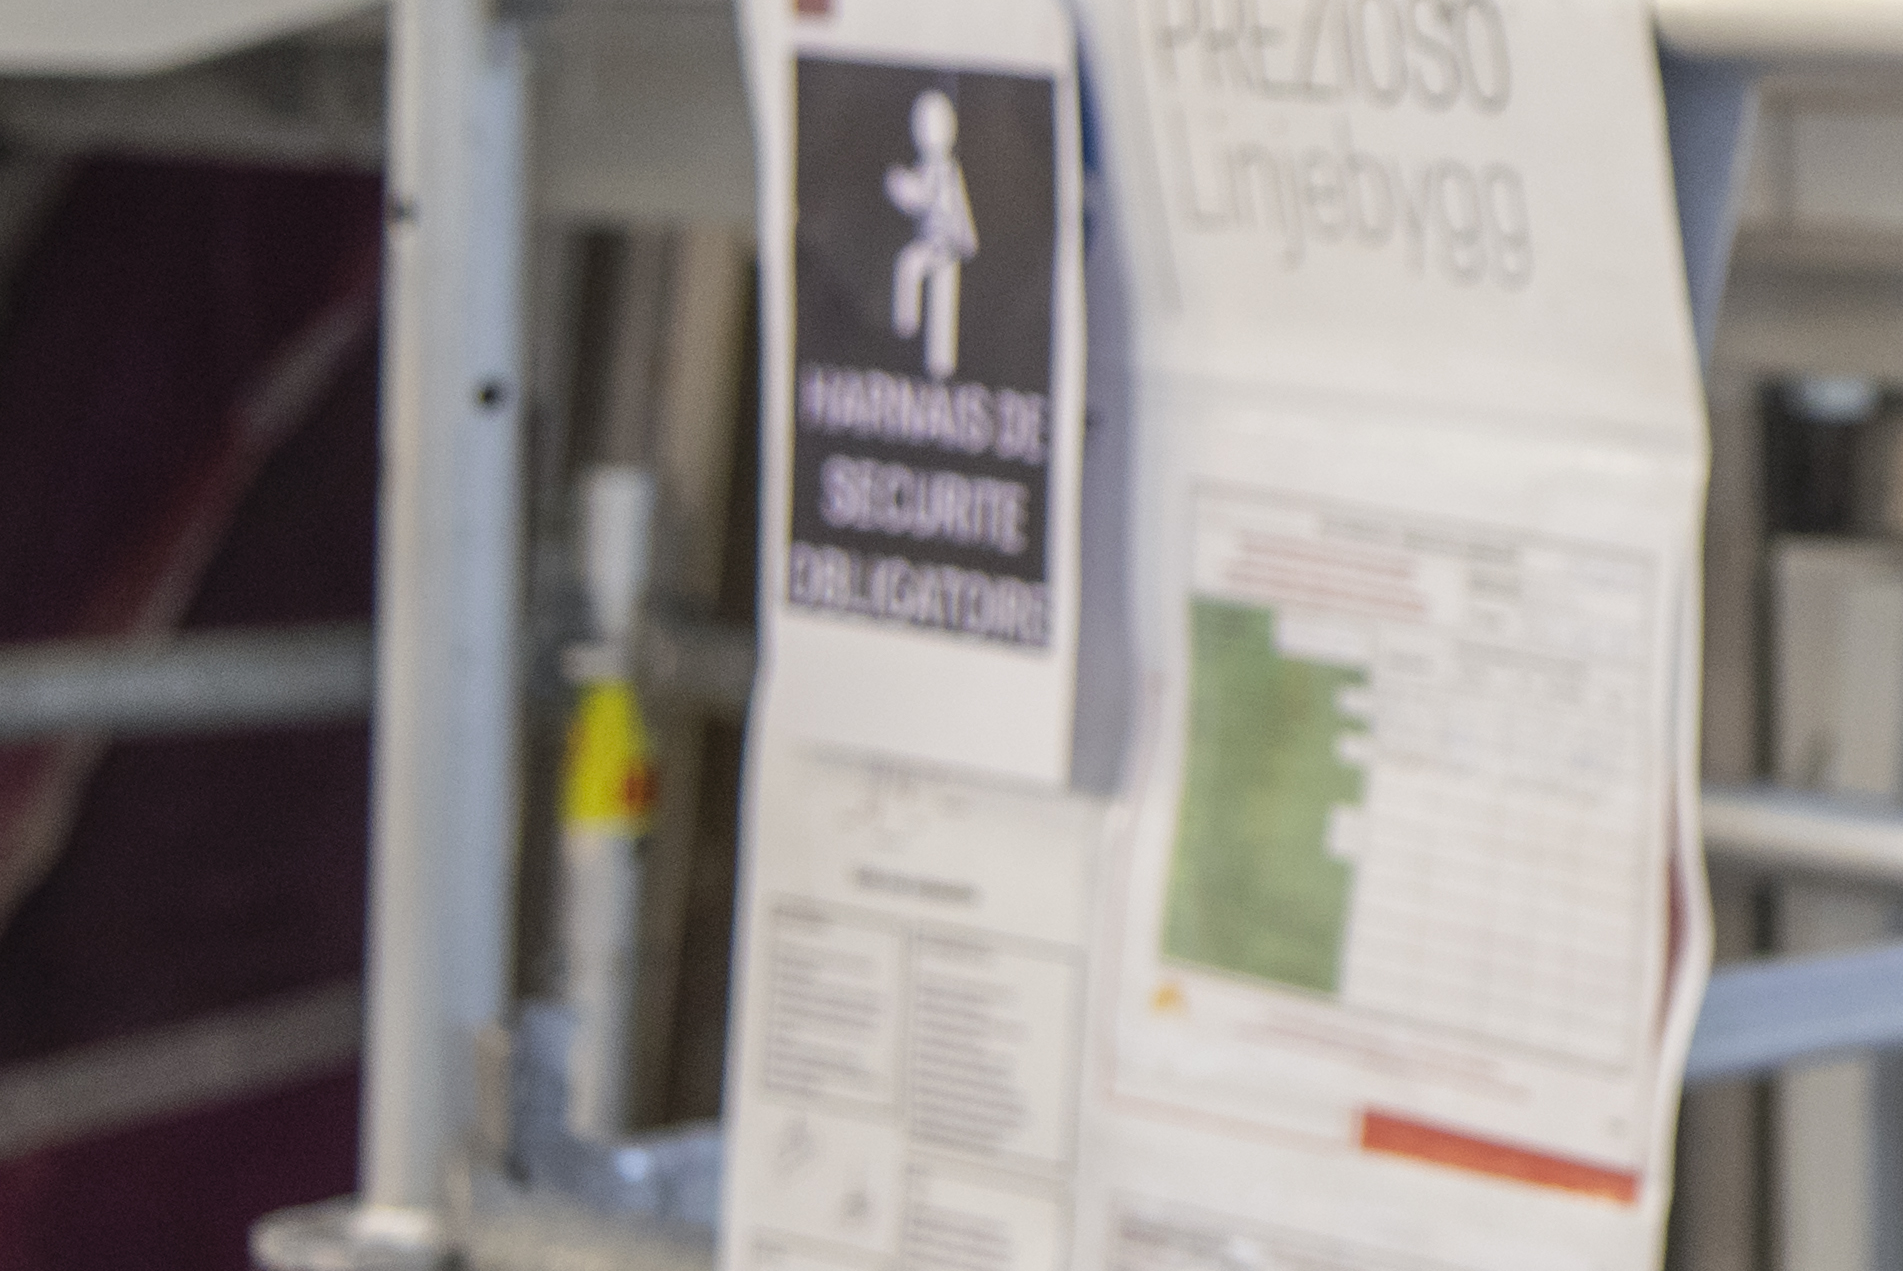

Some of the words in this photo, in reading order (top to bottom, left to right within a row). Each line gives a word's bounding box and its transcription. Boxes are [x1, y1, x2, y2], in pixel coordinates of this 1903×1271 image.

[1165, 104, 1535, 293] Linjebygg
[802, 365, 990, 457] HARNAIS
[995, 385, 1050, 465] DE
[820, 454, 1028, 557] SECURITE
[788, 543, 1052, 651] OBLIGATOIRE
